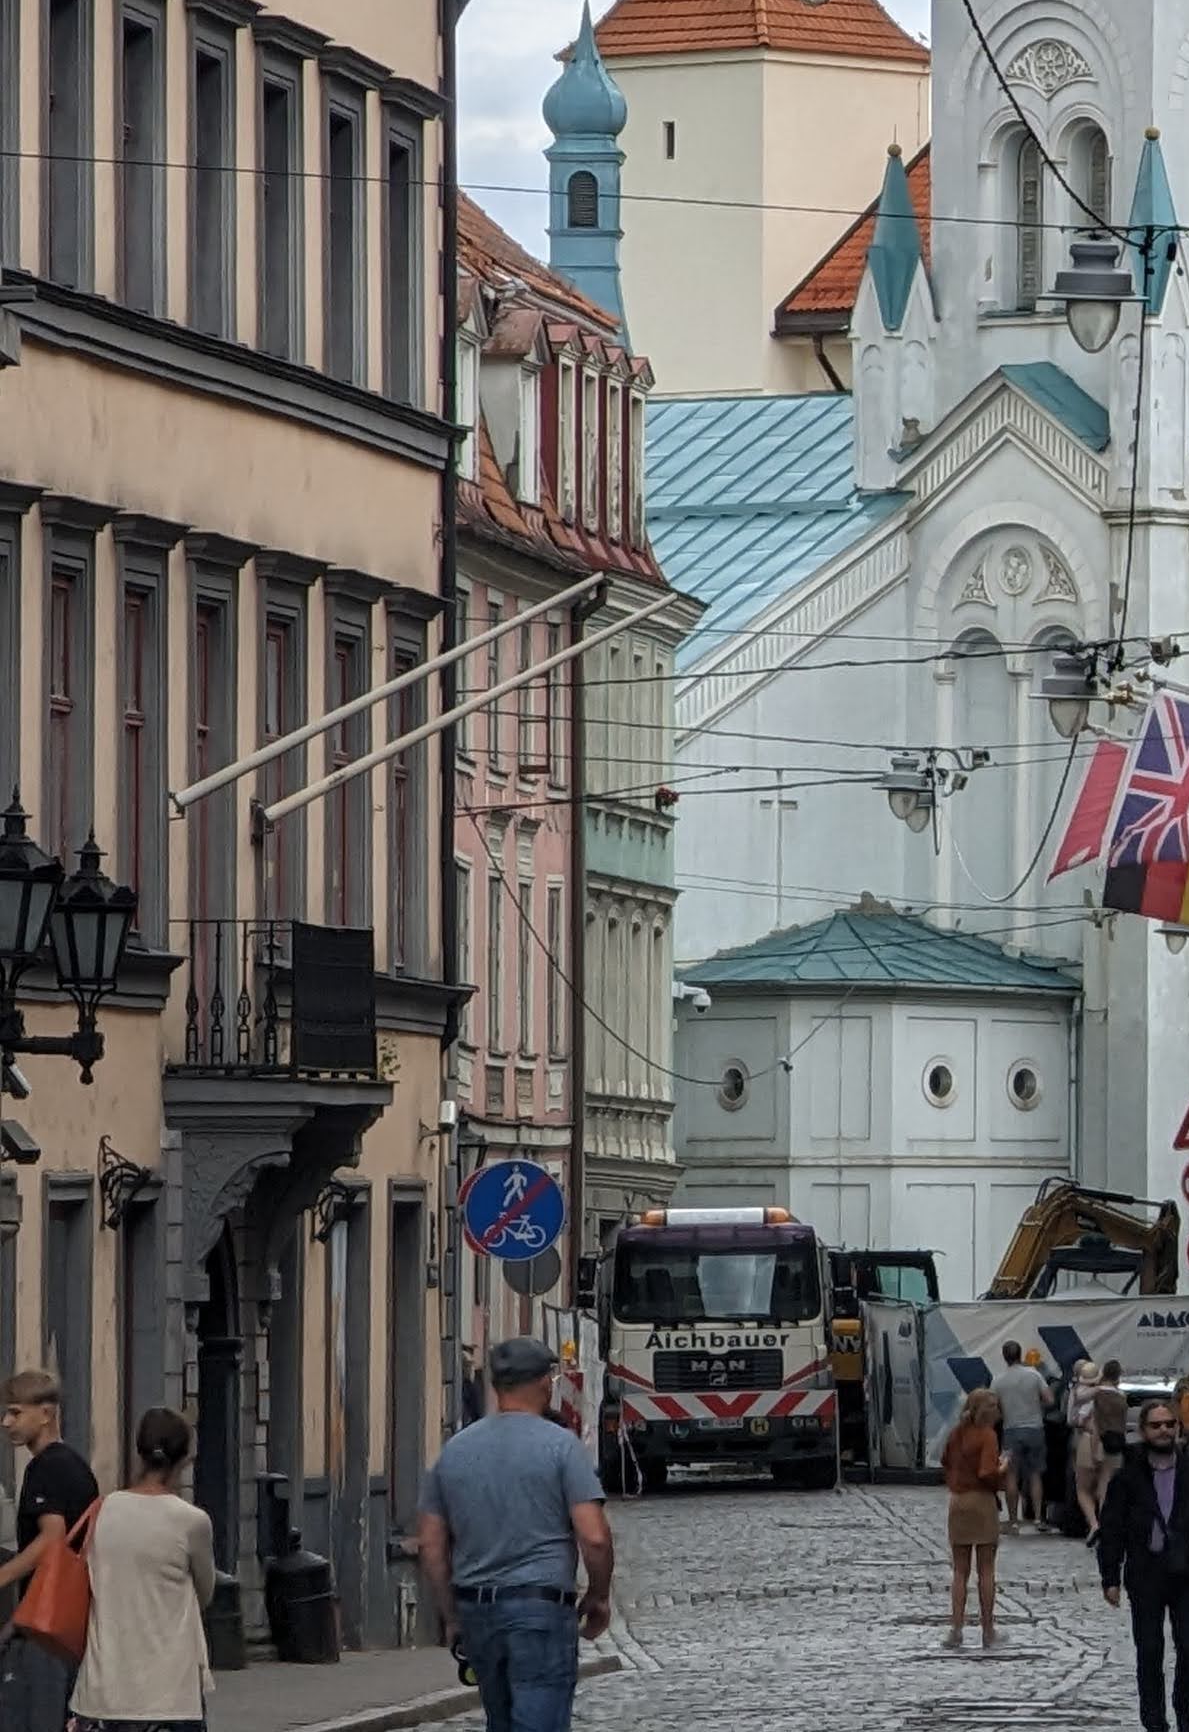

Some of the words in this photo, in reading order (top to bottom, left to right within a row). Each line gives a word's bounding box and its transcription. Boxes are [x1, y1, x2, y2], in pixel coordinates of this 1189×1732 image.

[645, 1331, 790, 1349] Aichbauer
[690, 1359, 746, 1372] MAN
[754, 1420, 766, 1433] H
